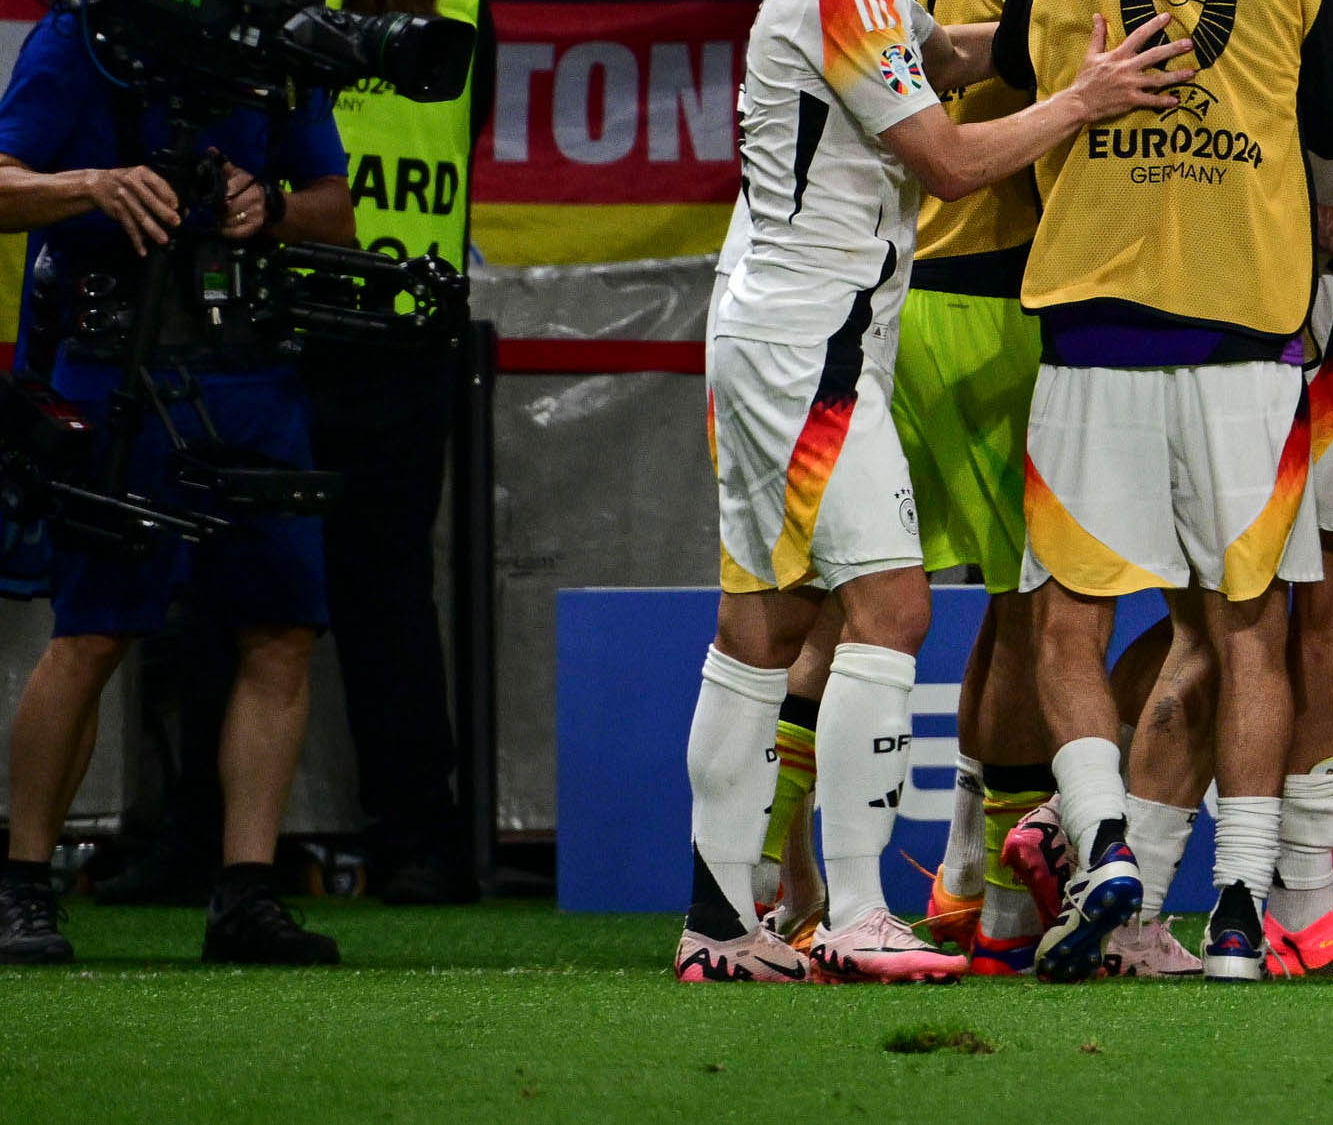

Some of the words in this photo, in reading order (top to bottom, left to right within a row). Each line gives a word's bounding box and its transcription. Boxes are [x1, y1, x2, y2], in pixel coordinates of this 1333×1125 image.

[1087, 124, 1263, 170] EURO2024
[350, 153, 459, 216] ARD
[1130, 160, 1228, 186] GERMANY
